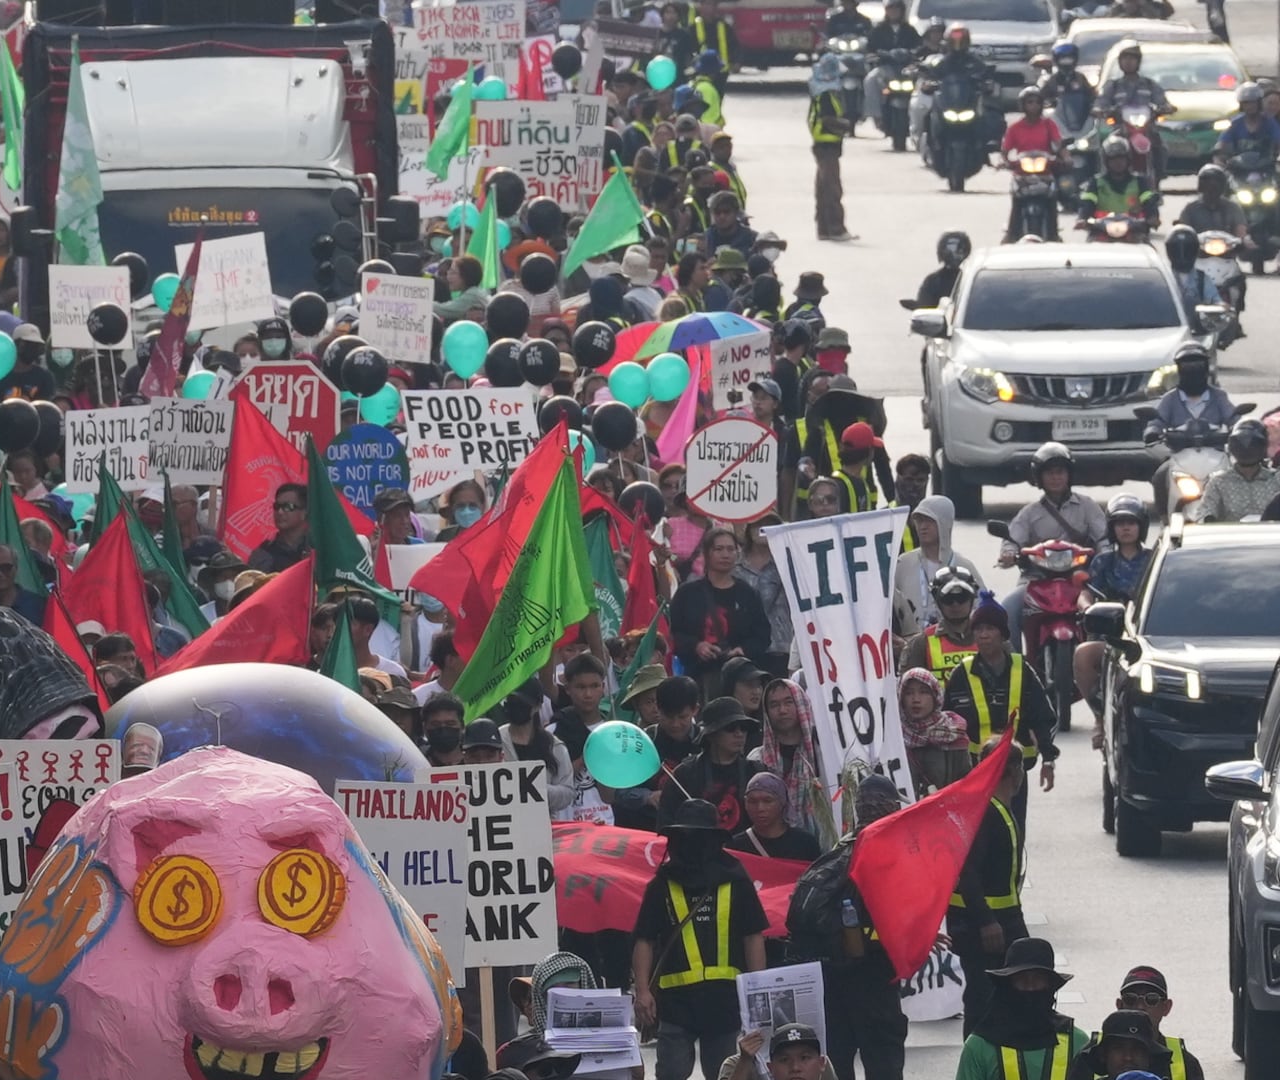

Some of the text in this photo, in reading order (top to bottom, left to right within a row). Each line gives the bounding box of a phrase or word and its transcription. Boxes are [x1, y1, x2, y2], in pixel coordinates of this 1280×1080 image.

[517, 108, 570, 146] ที่ดิน
[731, 344, 751, 364] NO
[754, 347, 771, 359] mo
[732, 369, 751, 385] NO
[754, 371, 771, 381] mo
[405, 396, 524, 422] FOOD for
[69, 410, 150, 448] พลังงานส
[327, 442, 394, 461] OUR WORLD
[412, 438, 530, 465] not for PROFI
[345, 465, 373, 481] NOT
[378, 464, 402, 481] FOR
[807, 621, 838, 686] is
[338, 783, 468, 824] THAILAND'S
[467, 814, 514, 853] HE
[403, 849, 463, 887] HELL
[467, 856, 556, 897] ORLD
[465, 901, 541, 942] ANK
